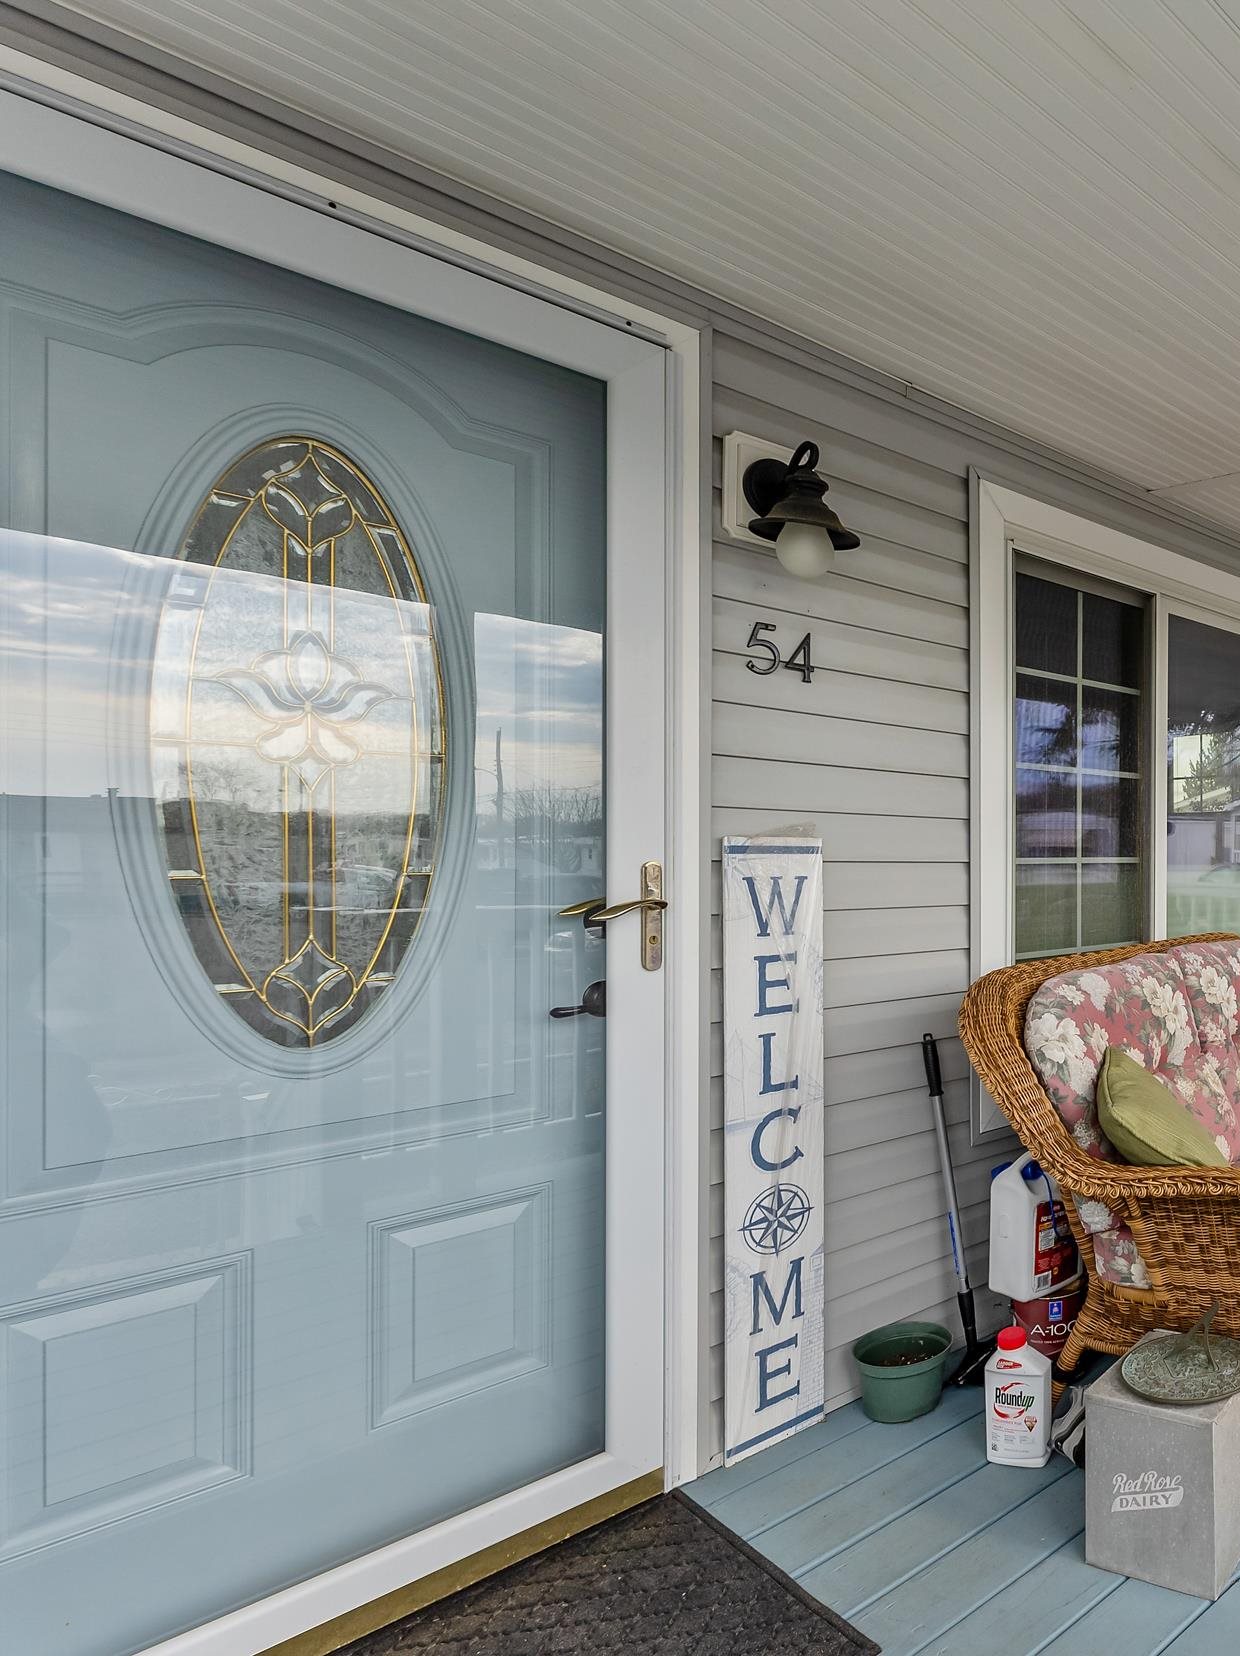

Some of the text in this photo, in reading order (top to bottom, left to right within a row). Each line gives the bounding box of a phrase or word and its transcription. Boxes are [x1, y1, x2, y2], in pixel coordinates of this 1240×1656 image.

[746, 622, 814, 683] 54
[995, 1387, 1035, 1412] Roundup
[1112, 1470, 1182, 1494] Red Rose
[1119, 1493, 1174, 1509] DAIRY
